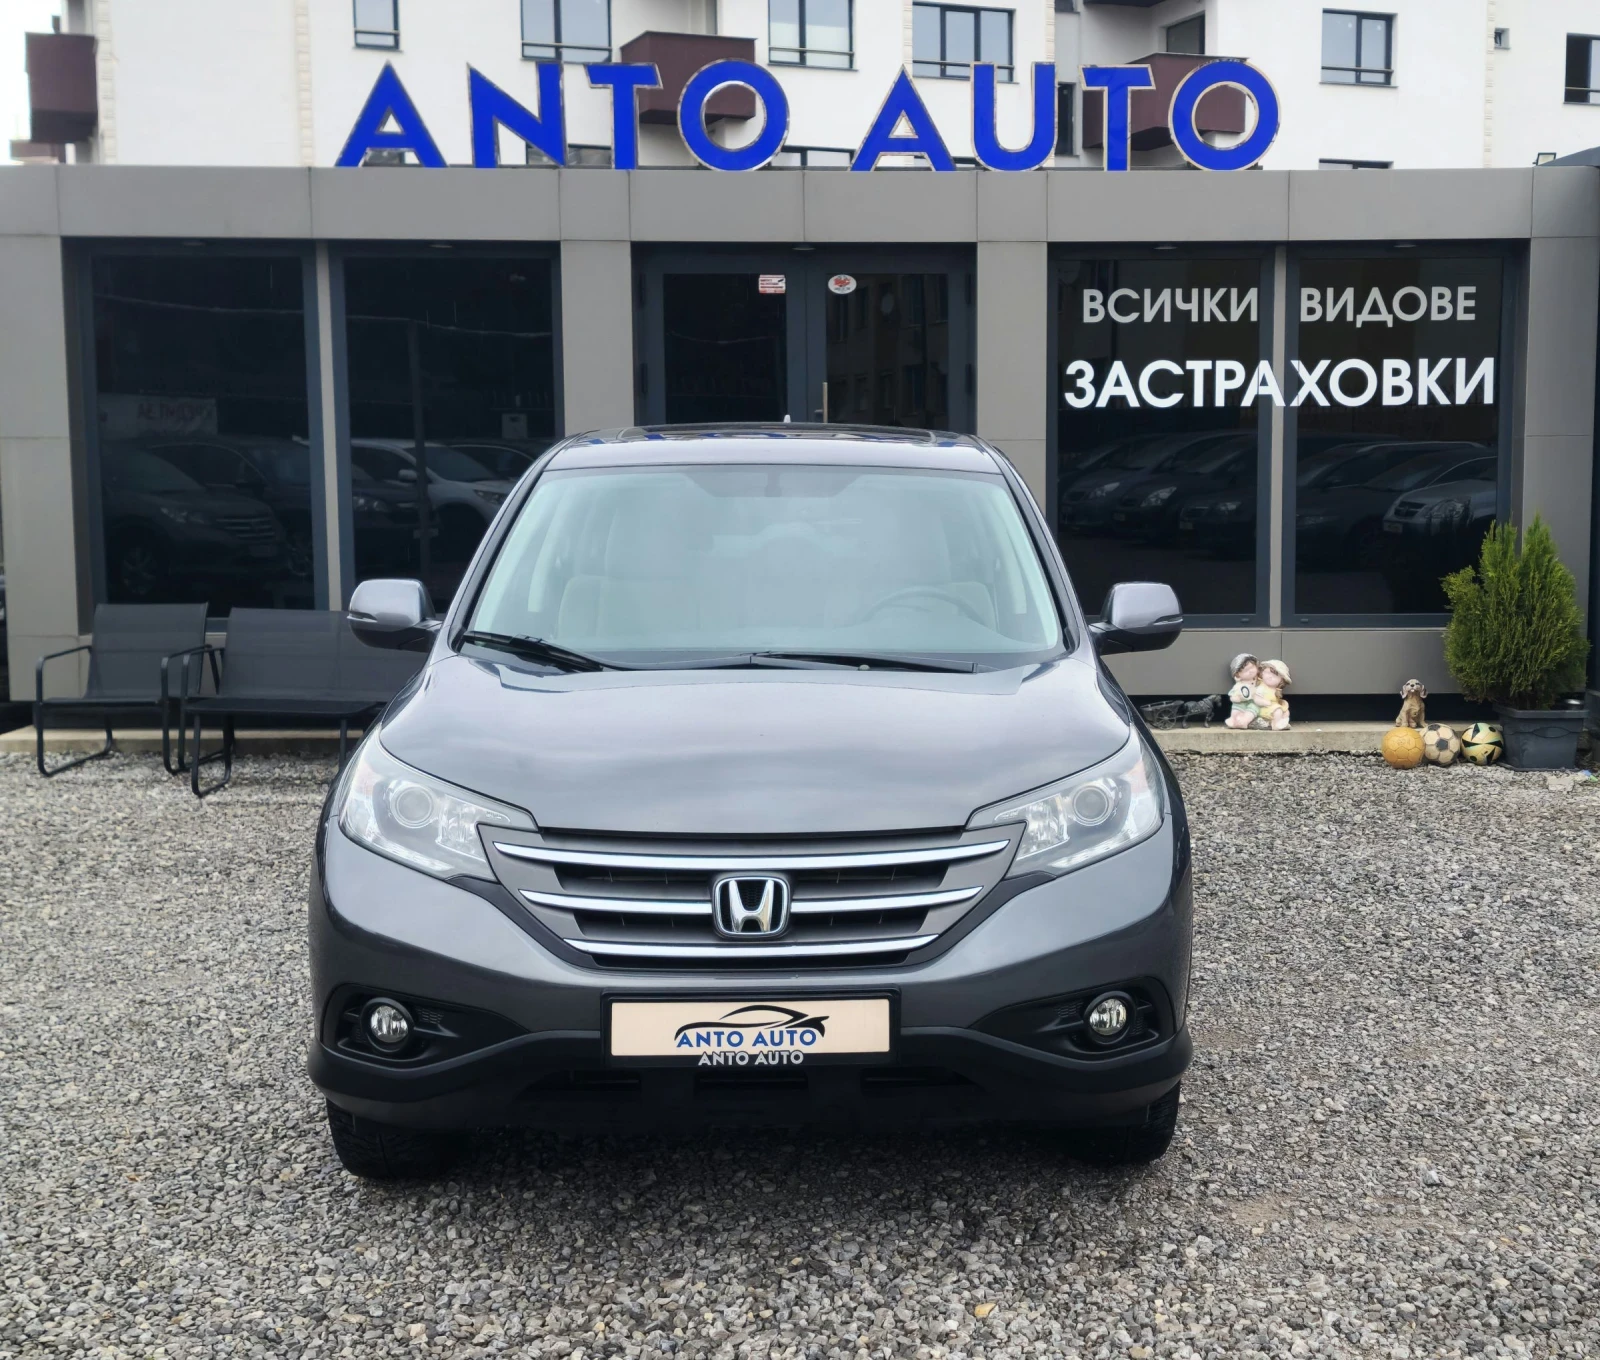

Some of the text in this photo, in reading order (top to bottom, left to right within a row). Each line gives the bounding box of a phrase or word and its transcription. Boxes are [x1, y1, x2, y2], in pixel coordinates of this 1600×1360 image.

[336, 58, 1281, 171] ANTO AUTO
[1082, 285, 1477, 328] ВСИЧКИ ВИДОВЕ
[1064, 356, 1496, 409] ЗАСТРАХОВКИ
[676, 1029, 817, 1048] ANTO AUTO
[697, 1049, 805, 1067] ANTO AUTO
